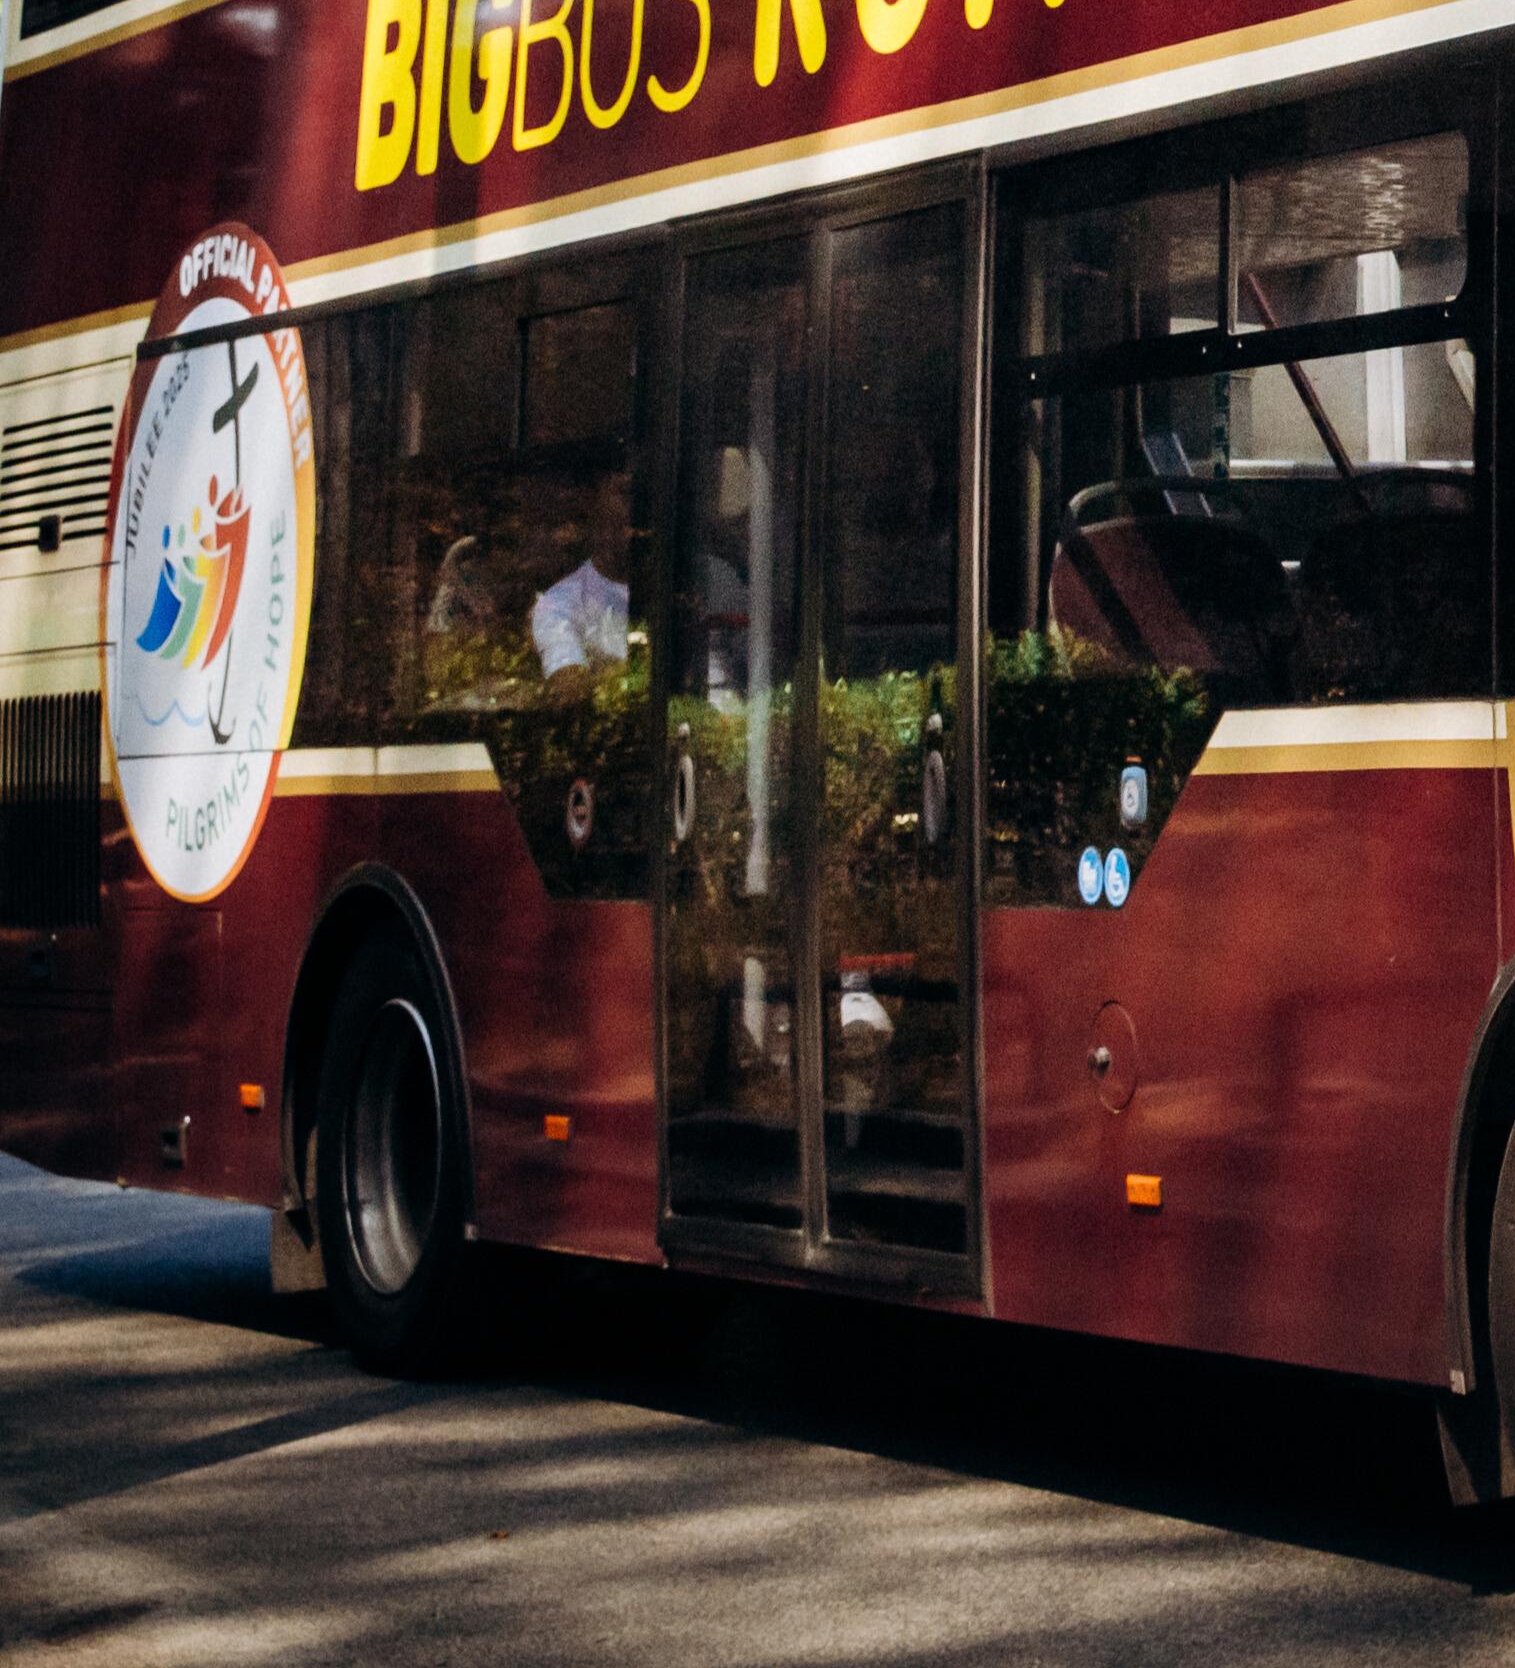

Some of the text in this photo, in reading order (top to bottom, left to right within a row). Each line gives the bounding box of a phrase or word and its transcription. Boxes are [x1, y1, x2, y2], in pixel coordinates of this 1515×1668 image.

[179, 233, 256, 298] OFFICIAL
[165, 508, 288, 853] PILGRIMS OF HOPE
